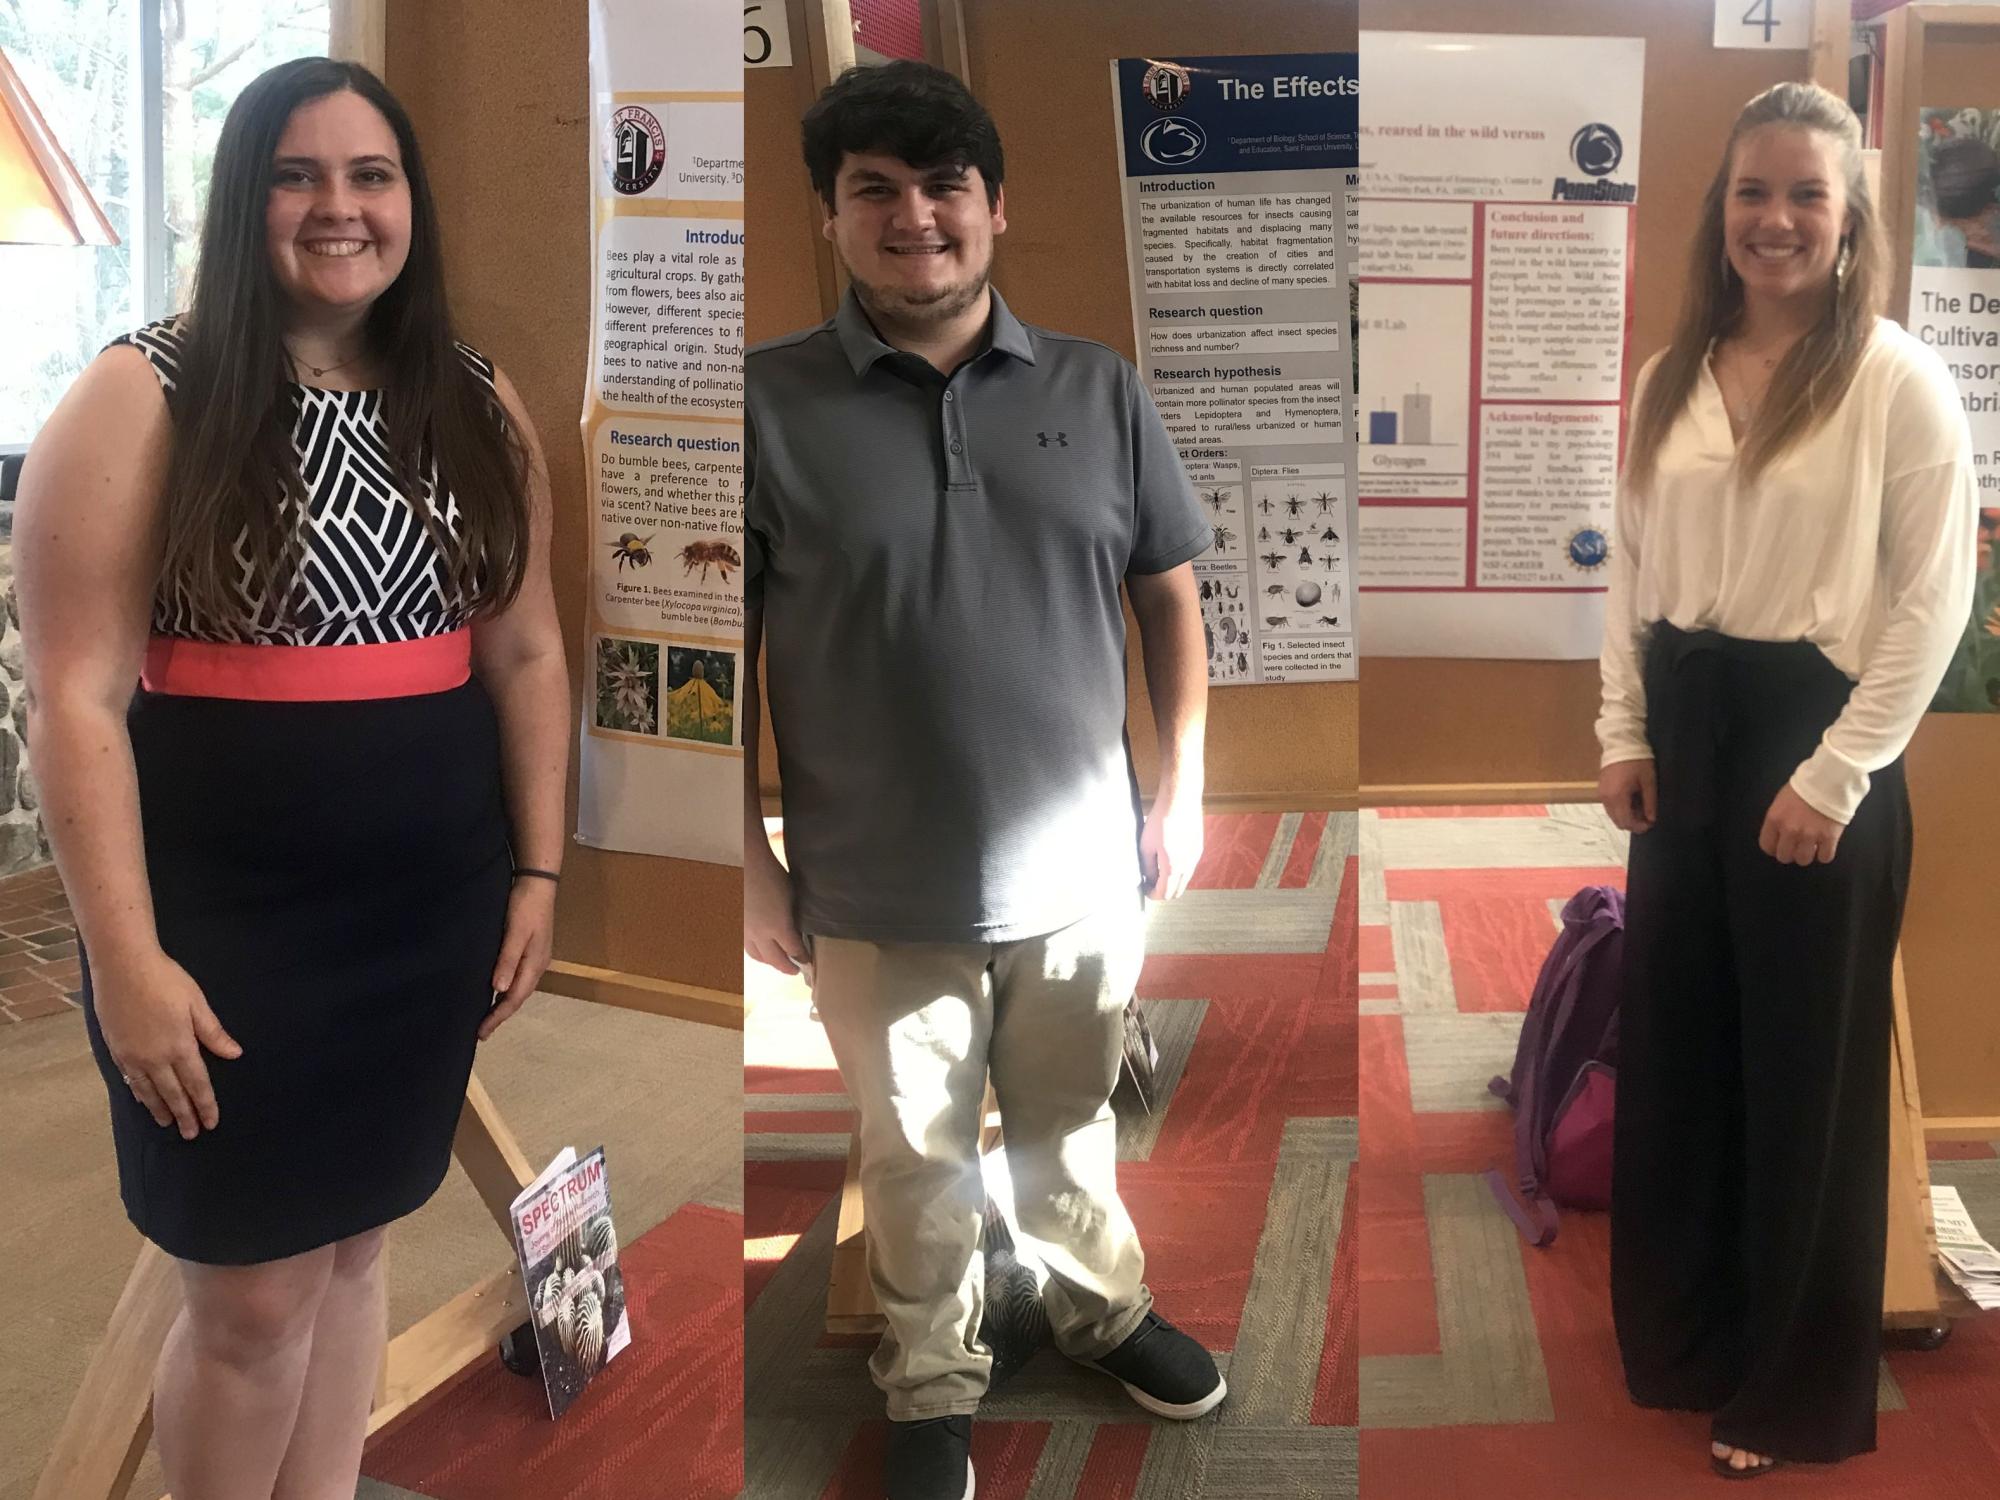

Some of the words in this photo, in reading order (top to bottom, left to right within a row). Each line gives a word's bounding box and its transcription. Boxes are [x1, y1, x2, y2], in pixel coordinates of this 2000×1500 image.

[1742, 0, 1780, 42] 4
[1218, 79, 1264, 100] The
[1273, 75, 1359, 98] Effects
[1378, 124, 1422, 138] reared
[1427, 124, 1440, 138] in
[1445, 125, 1466, 138] the
[1470, 126, 1498, 139] wild
[1503, 129, 1545, 140] versus
[1140, 179, 1215, 193] Introduction
[1141, 202, 1156, 211] The
[1161, 200, 1210, 209] urbanization
[1227, 198, 1255, 207] human
[1276, 197, 1291, 206] has
[1296, 196, 1331, 206] changed
[1160, 214, 1196, 223] available
[1202, 213, 1242, 221] resources
[1265, 211, 1293, 219] insects
[1300, 209, 1331, 219] causing
[1491, 211, 1558, 223] Conclusion
[1562, 211, 1584, 223] and
[1143, 228, 1188, 237] fragmented
[1197, 226, 1229, 235] habitats
[1237, 225, 1252, 234] and
[1261, 224, 1301, 234] displacing
[1310, 224, 1332, 232] many
[1491, 229, 1528, 240] future
[1241, 238, 1268, 247] habitat
[1277, 236, 1332, 246] fragmentation
[607, 250, 628, 260] Bees
[634, 250, 654, 264] play
[672, 252, 693, 263] vital
[699, 254, 719, 264] role
[1145, 254, 1173, 262] caused
[1226, 252, 1259, 260] creation
[1287, 250, 1308, 258] cities
[1318, 249, 1333, 257] and
[606, 268, 661, 280] agricultural
[666, 271, 696, 282] crops.
[701, 272, 713, 284] By
[1146, 266, 1200, 276] transportation
[1207, 266, 1240, 274] systems
[1259, 263, 1287, 273] directly
[1293, 262, 1334, 271] correlated
[1164, 279, 1192, 288] habitat
[1230, 276, 1259, 285] decline
[1272, 276, 1293, 286] many
[606, 286, 627, 296] from
[632, 286, 672, 300] flowers,
[677, 288, 700, 299] bees
[705, 289, 726, 300] also
[1922, 291, 1960, 313] The
[606, 303, 650, 316] However,
[657, 305, 701, 317] different
[1149, 307, 1206, 319] Research
[1210, 305, 1263, 319] question
[605, 320, 646, 333] different
[652, 322, 713, 336] preferences
[1151, 332, 1167, 340] How
[1172, 331, 1192, 339] does
[1197, 330, 1246, 338] urbanization
[1250, 328, 1273, 337] affect
[1278, 327, 1301, 336] insect
[1306, 327, 1337, 337] species
[604, 340, 667, 352] geographical
[674, 342, 707, 355] origin.
[714, 344, 744, 358] Study
[1152, 344, 1184, 353] richness
[1204, 342, 1239, 351] number?
[604, 355, 626, 366] bees
[646, 358, 678, 369] native
[683, 360, 701, 370] and
[1154, 367, 1210, 379] Research
[1214, 365, 1281, 380] hypothesis
[603, 373, 675, 389] understanding
[679, 377, 690, 388] of
[1155, 386, 1194, 395] Urbanized
[1200, 385, 1215, 394] and
[1221, 385, 1248, 393] human
[1254, 383, 1293, 394] populated
[1299, 383, 1321, 391] areas
[603, 390, 618, 400] the
[622, 391, 654, 403] health
[670, 394, 688, 405] the
[1155, 400, 1183, 408] contain
[1209, 399, 1245, 407] pollinator
[1248, 397, 1278, 406] species
[1317, 395, 1340, 403] insect
[1195, 411, 1242, 420] Lepidoptera
[1256, 409, 1271, 417] and
[1256, 421, 1295, 430] urbanized
[1314, 420, 1341, 428] human
[611, 430, 672, 448] Research
[677, 438, 740, 452] question
[1191, 449, 1228, 458] Orders:
[602, 453, 614, 464] Do
[619, 454, 658, 468] bumble
[662, 458, 690, 472] bees,
[602, 468, 624, 479] have
[651, 473, 707, 486] preference
[1282, 467, 1300, 475] Flies
[601, 482, 640, 497] flowers,
[645, 487, 663, 497] and
[668, 489, 712, 501] whether
[715, 492, 734, 503] this
[601, 499, 614, 508] via
[618, 500, 650, 511] scent?
[655, 502, 688, 514] Native
[692, 504, 716, 516] bees
[720, 510, 736, 518] are
[602, 513, 631, 524] native
[634, 517, 657, 526] over
[661, 518, 718, 531] non-native
[1210, 563, 1237, 571] Beetles
[617, 583, 641, 593] Figure
[654, 586, 671, 595] Bees
[674, 589, 712, 600] examined
[725, 594, 738, 602] the
[606, 593, 642, 605] Carpenter
[645, 596, 660, 607] bee
[662, 599, 700, 611] (Xylocopa
[703, 604, 742, 616] virginica),
[662, 611, 692, 622] bumble
[694, 614, 708, 624] bee
[1264, 653, 1292, 661] species
[1265, 674, 1286, 682] study
[522, 1161, 601, 1235] SPECTRUM
